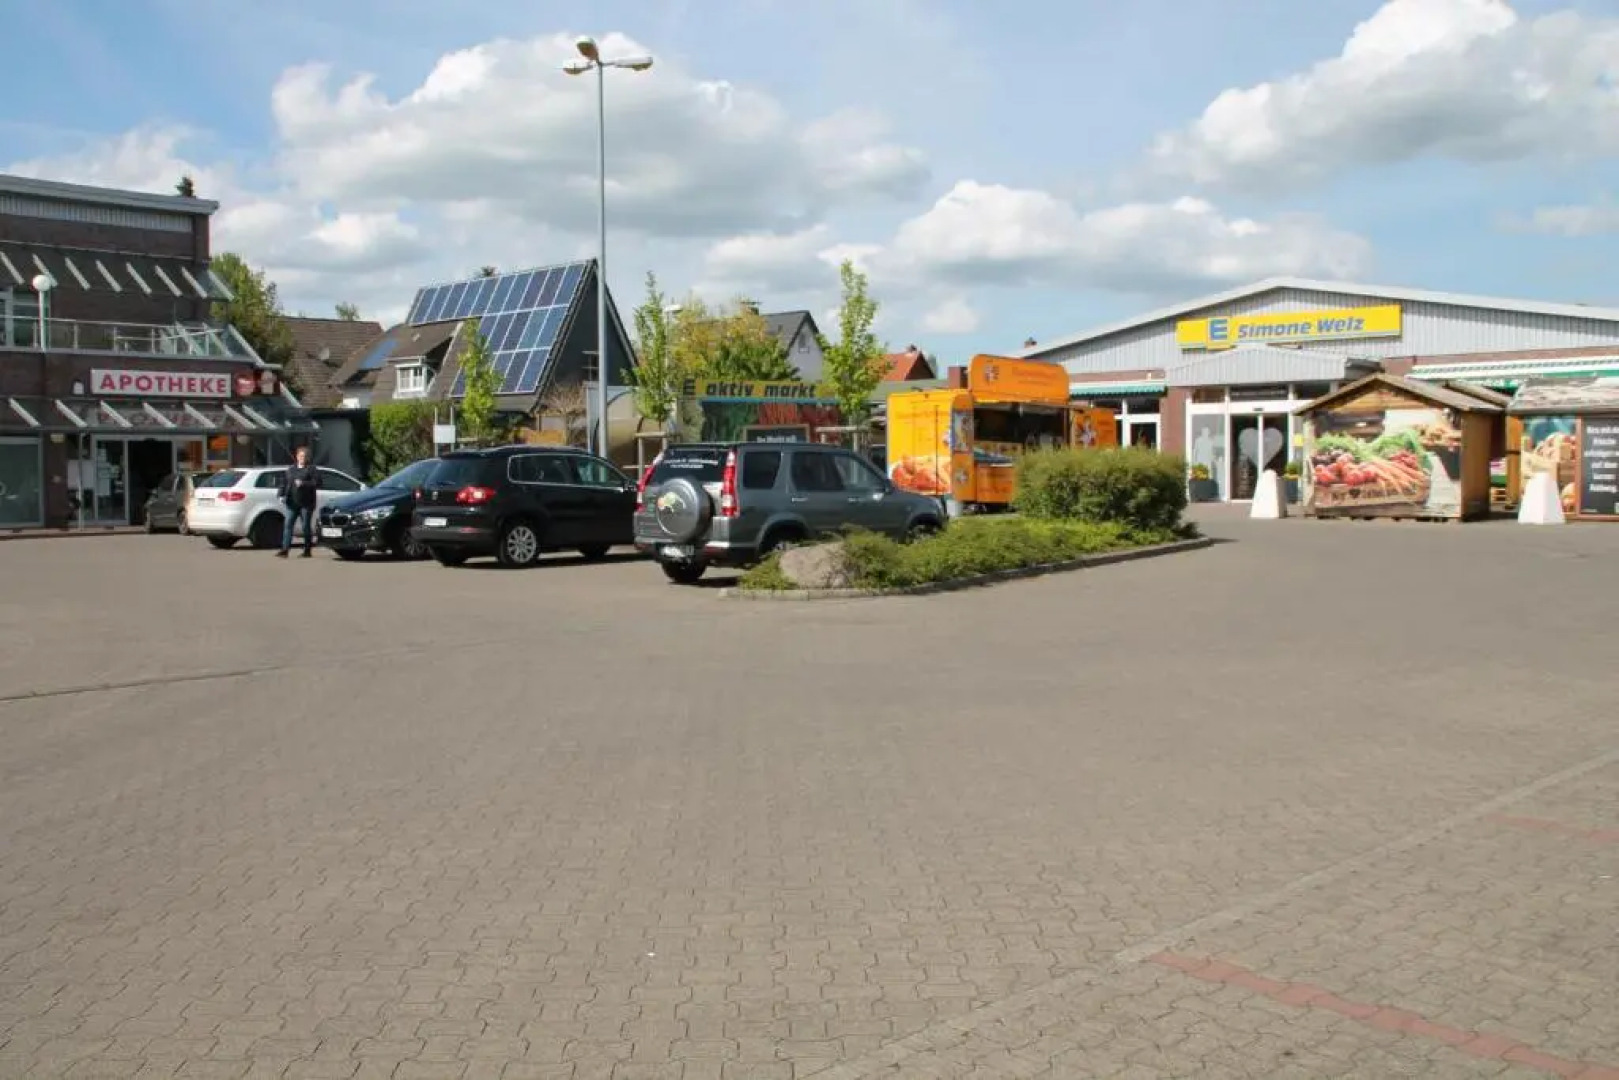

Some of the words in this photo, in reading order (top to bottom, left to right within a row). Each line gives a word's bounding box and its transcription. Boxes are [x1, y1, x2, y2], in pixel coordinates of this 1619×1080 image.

[1210, 318, 1228, 339] E
[1317, 316, 1364, 332] Welz
[100, 374, 227, 393] APOTHEKE
[706, 382, 754, 396] aktiv
[765, 383, 817, 397] markt
